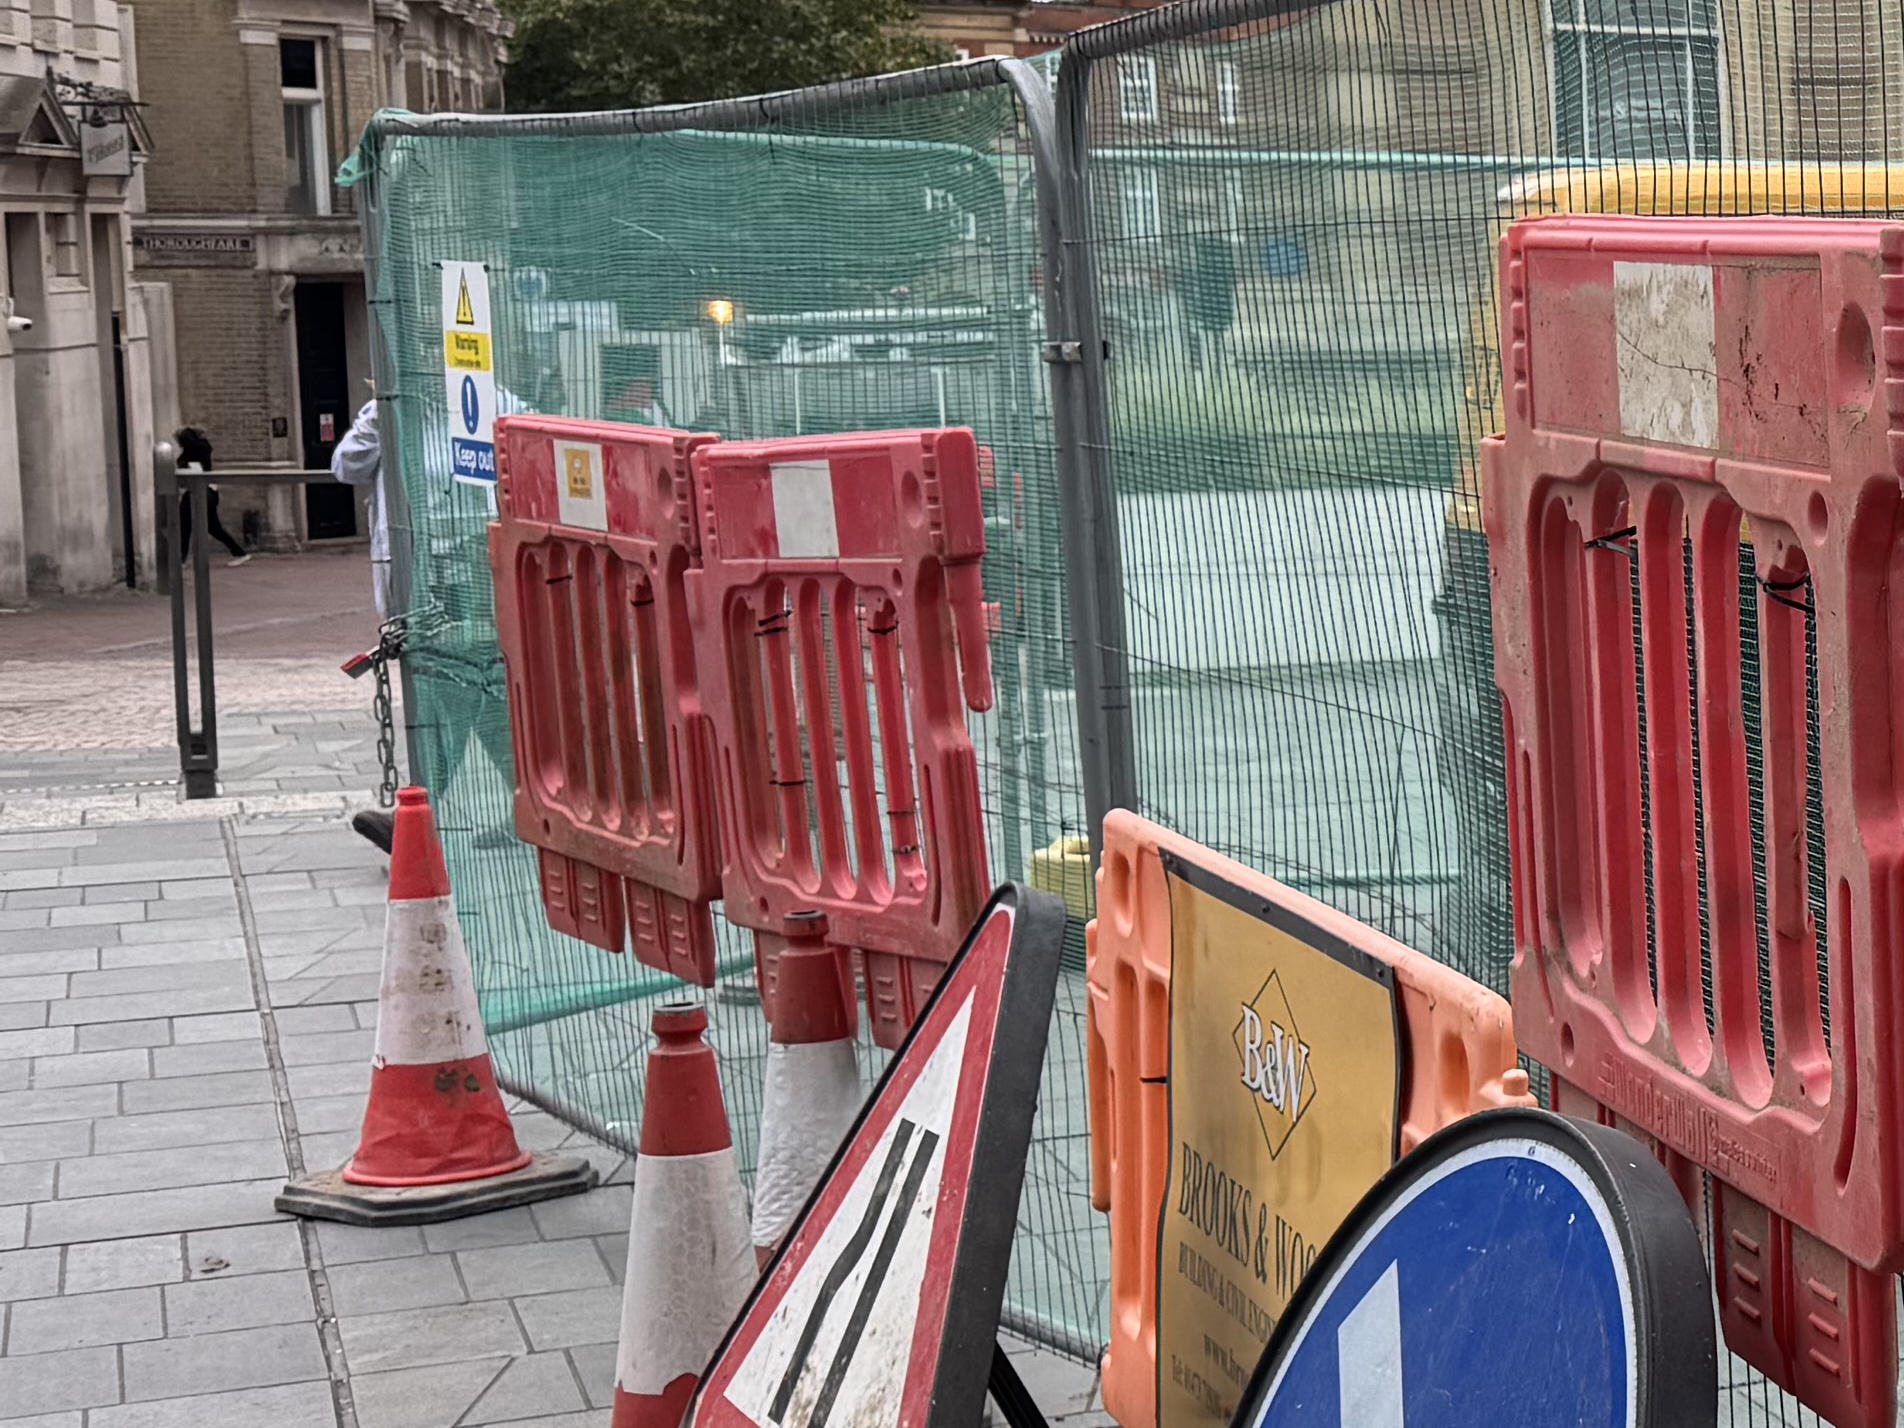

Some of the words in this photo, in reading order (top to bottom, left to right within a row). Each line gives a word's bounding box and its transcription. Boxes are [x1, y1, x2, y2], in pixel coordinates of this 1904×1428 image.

[454, 441, 477, 474] Keep
[478, 449, 496, 472] out
[1241, 1002, 1311, 1123] B&W
[1178, 1141, 1251, 1268] BROOKS
[1254, 1202, 1268, 1284] &
